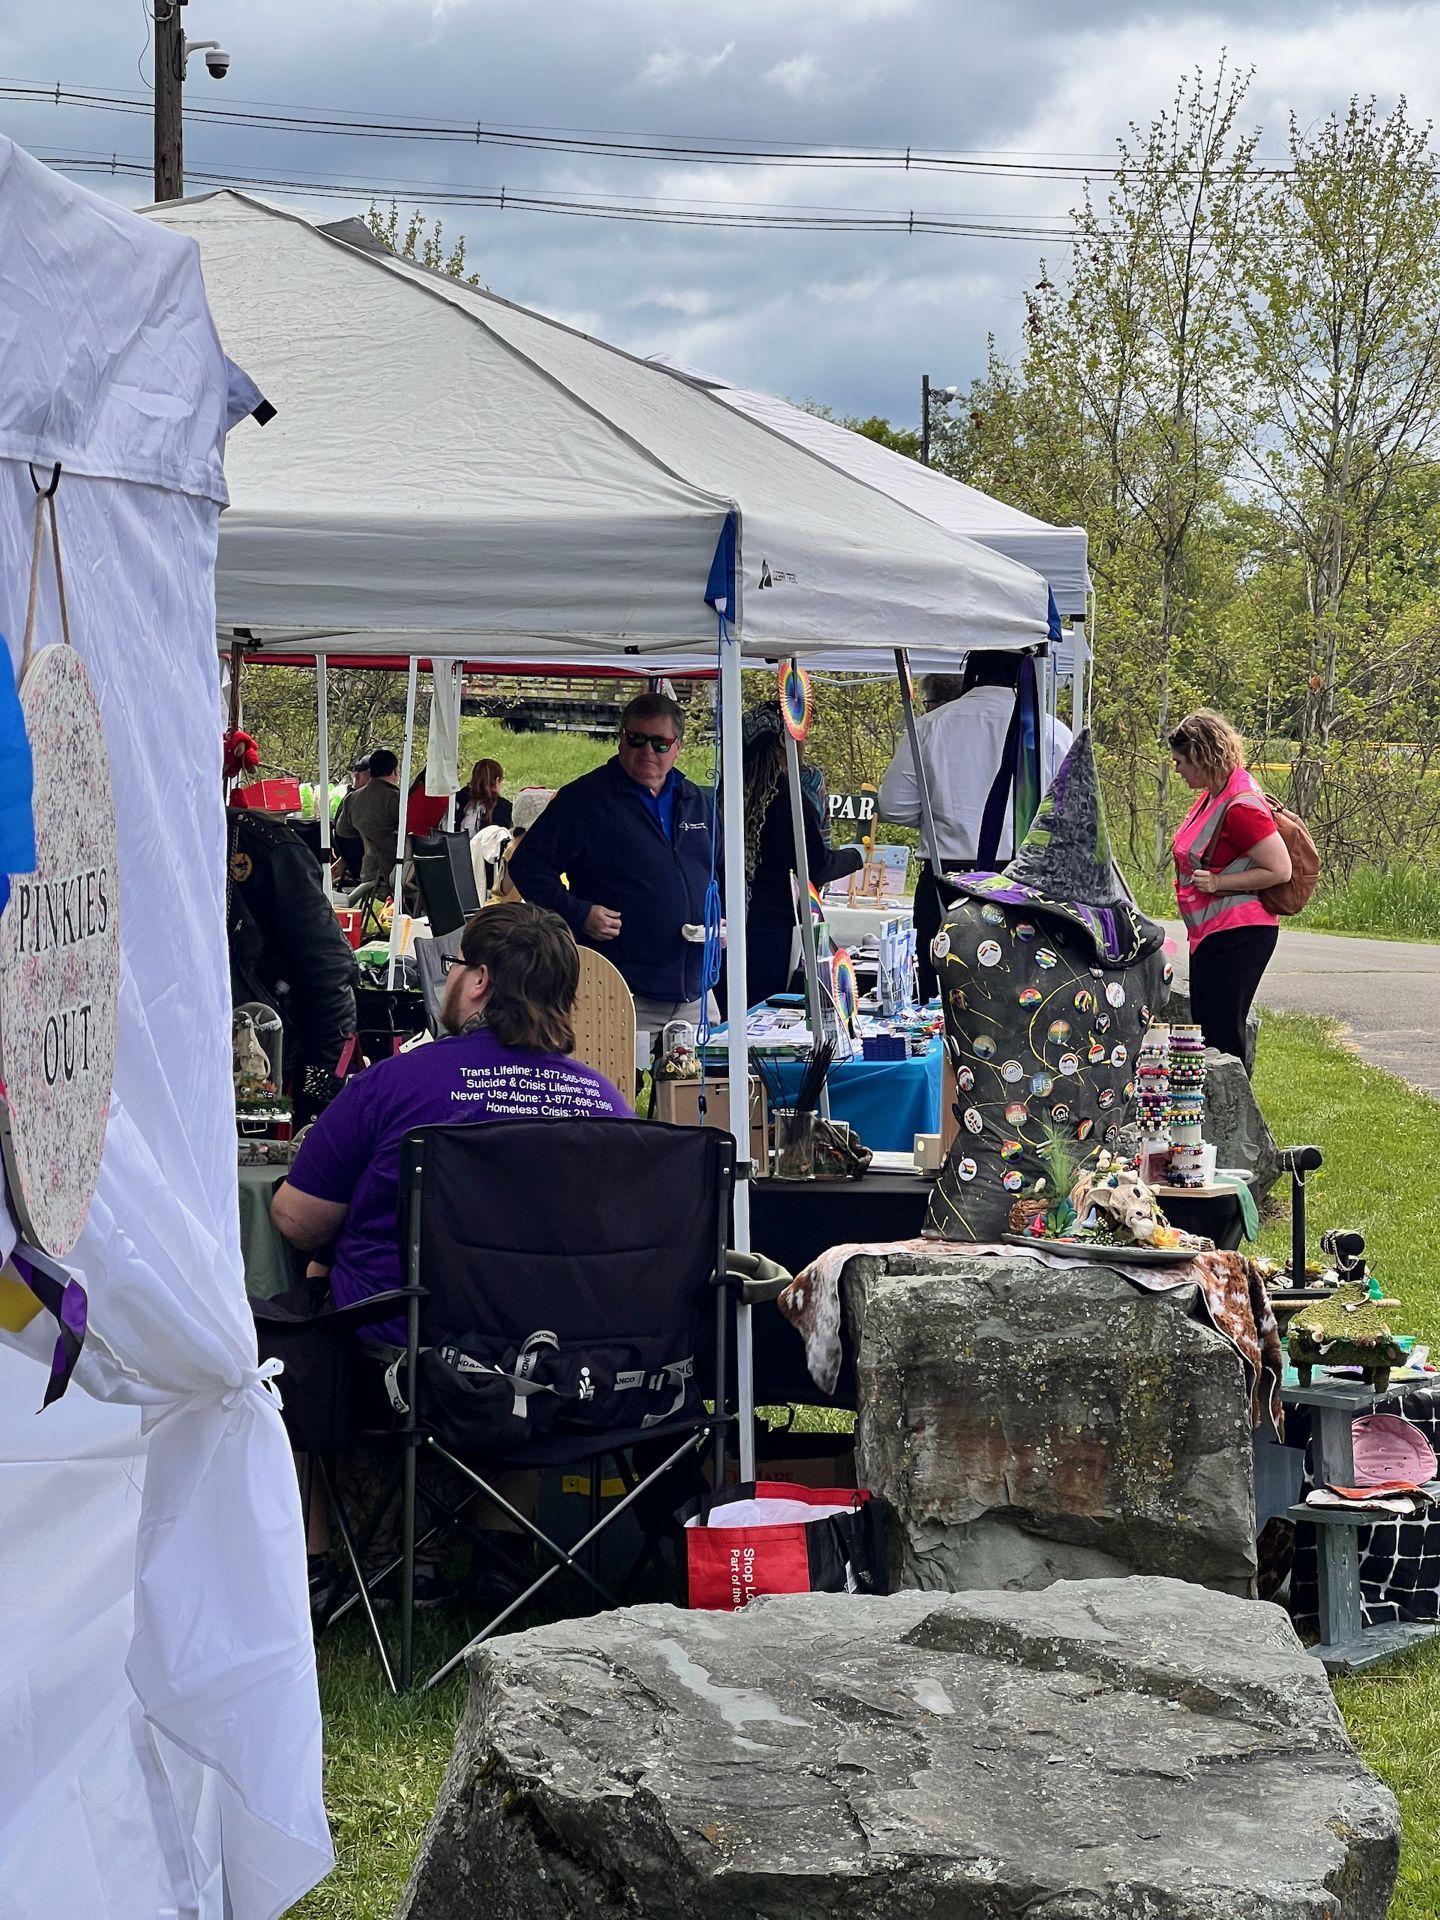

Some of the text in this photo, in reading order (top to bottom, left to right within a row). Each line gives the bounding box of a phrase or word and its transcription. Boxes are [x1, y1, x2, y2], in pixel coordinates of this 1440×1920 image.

[18, 868, 108, 953] PINKIES
[44, 1005, 92, 1087] OUT
[460, 1067, 490, 1077] Trans
[493, 1065, 533, 1076] Lifeline:
[450, 1091, 484, 1100] Never
[487, 1089, 508, 1100] Use
[509, 1090, 542, 1103] Alone:
[466, 1077, 601, 1098] Suicide & Crisis Lifeline: 988
[486, 1101, 590, 1117] Homeless Crisis: 211
[730, 1549, 741, 1573] Part
[742, 1547, 755, 1582] Shop
[731, 1575, 741, 1586] of
[732, 1586, 741, 1604] the
